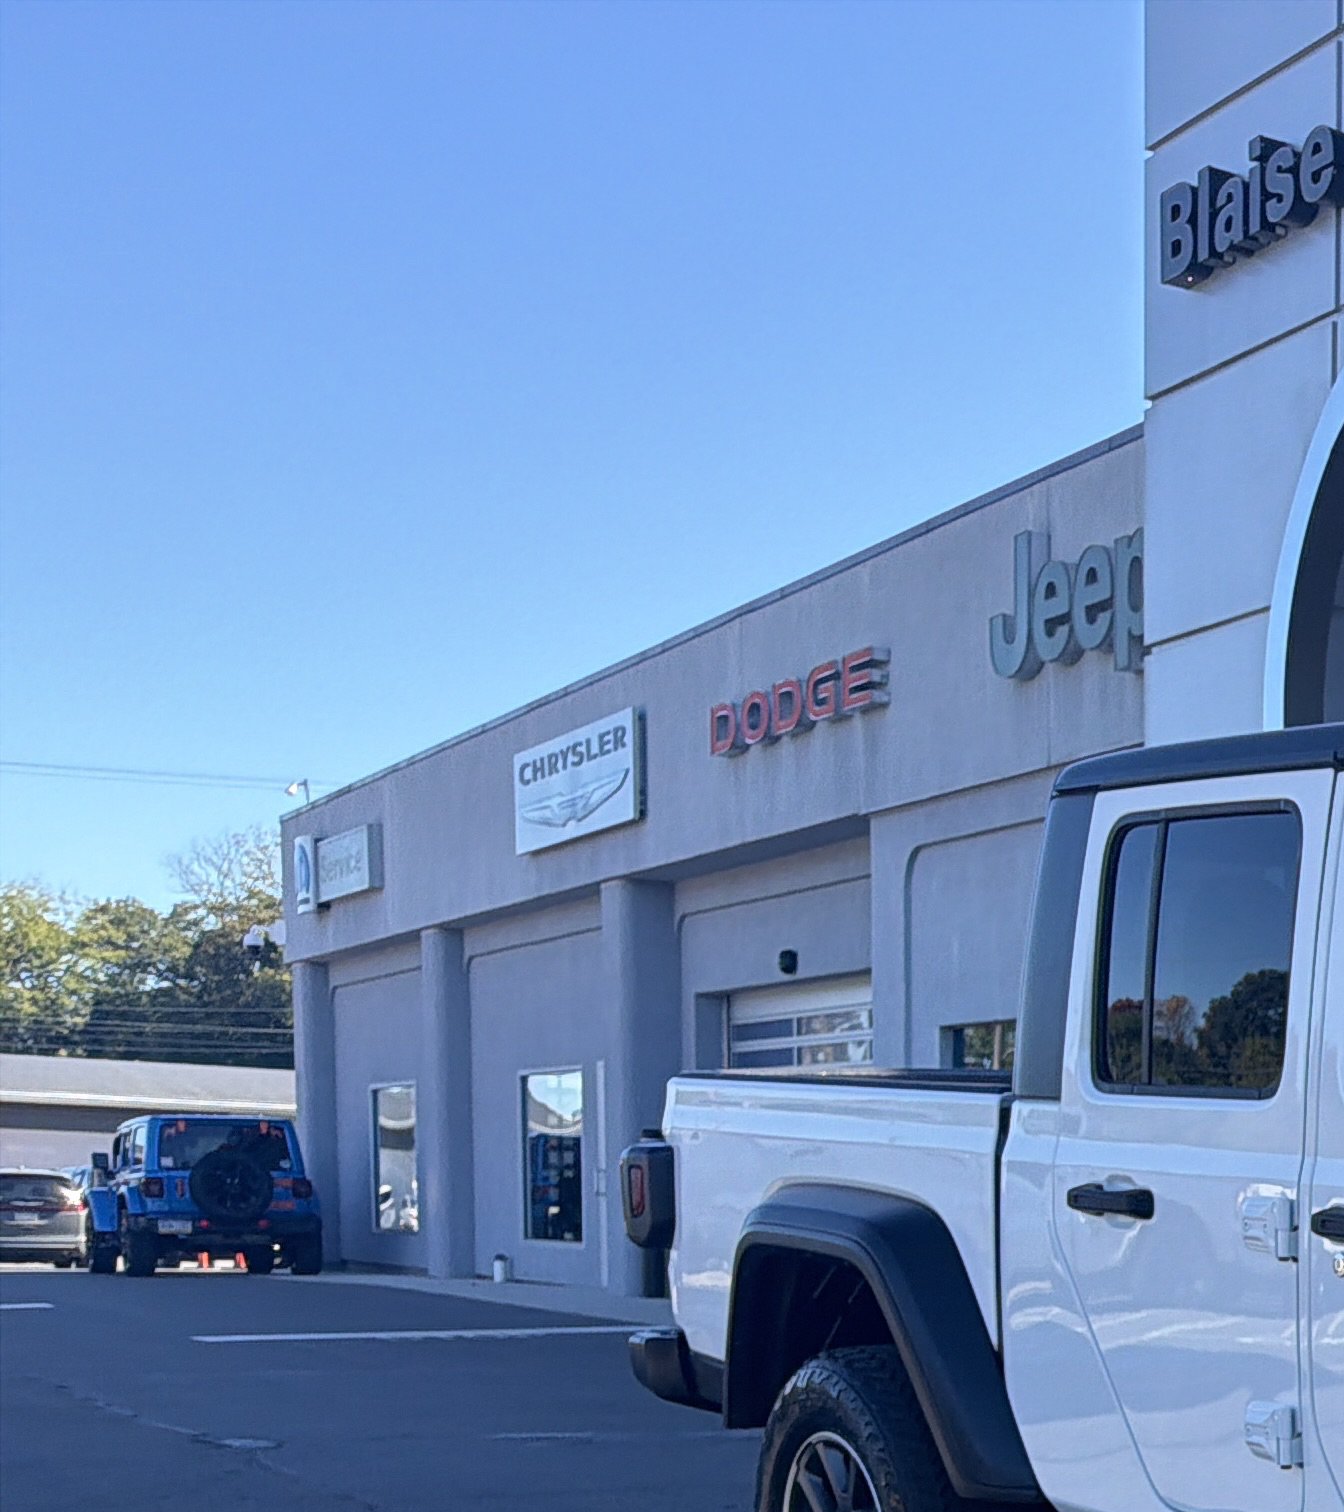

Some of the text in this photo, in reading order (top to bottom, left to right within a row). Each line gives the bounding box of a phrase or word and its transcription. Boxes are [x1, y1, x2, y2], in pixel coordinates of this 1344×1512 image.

[989, 527, 1144, 679] Jeep
[518, 725, 627, 786] CHRYSLER
[710, 646, 880, 757] DODGE
